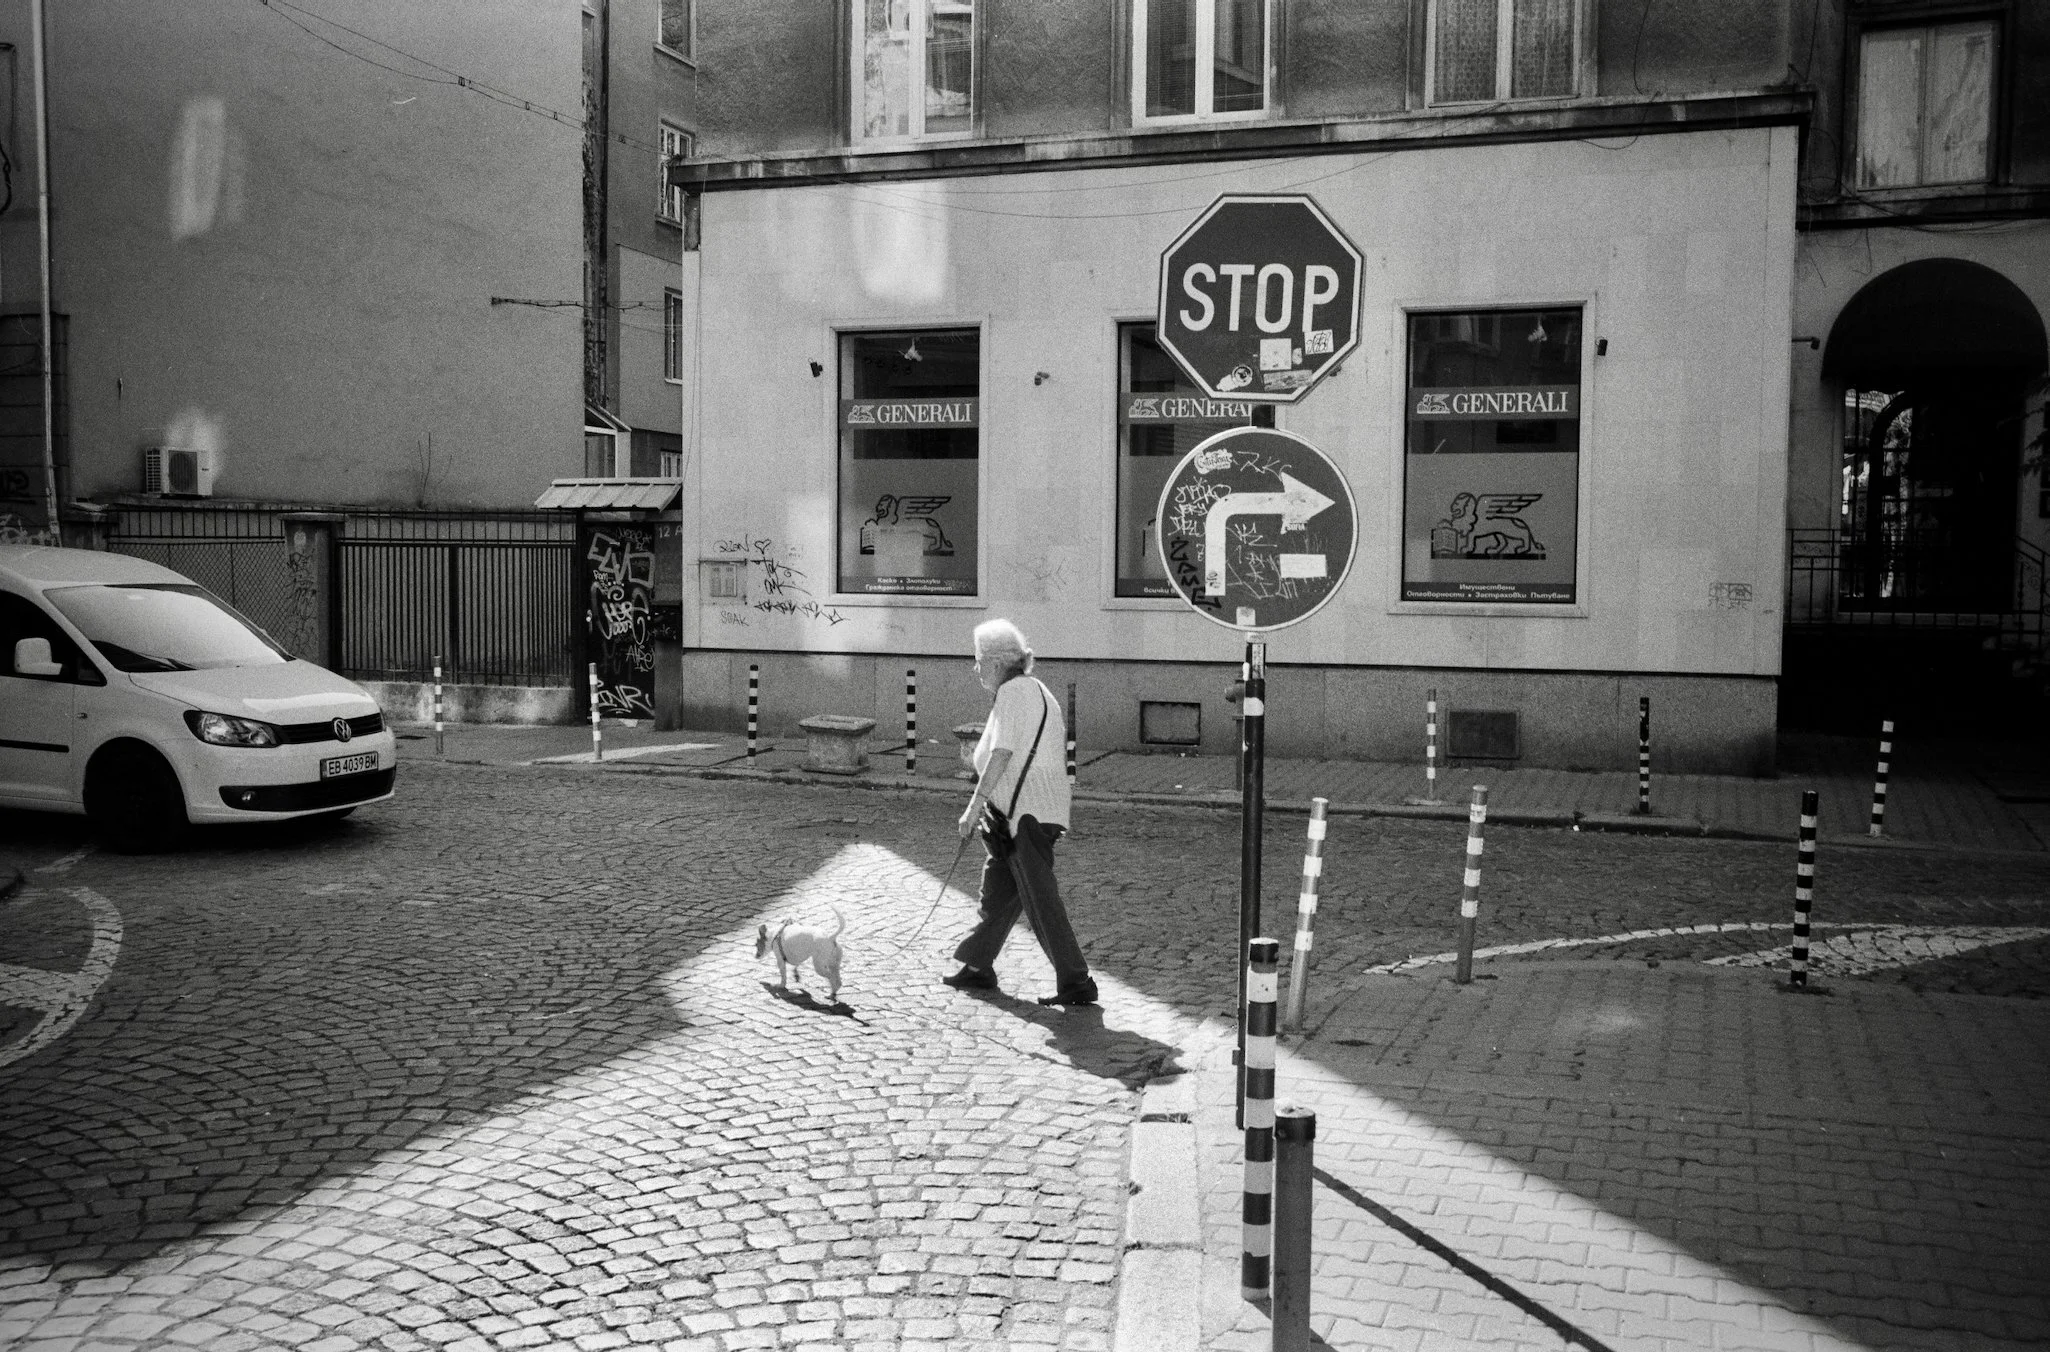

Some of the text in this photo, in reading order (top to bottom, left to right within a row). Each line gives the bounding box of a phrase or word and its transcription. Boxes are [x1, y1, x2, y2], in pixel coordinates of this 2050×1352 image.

[1180, 263, 1339, 333] STOP
[877, 403, 972, 423] GENERALI
[1453, 391, 1568, 414] GENERALI
[328, 760, 341, 775] EB
[343, 757, 364, 773] 4039
